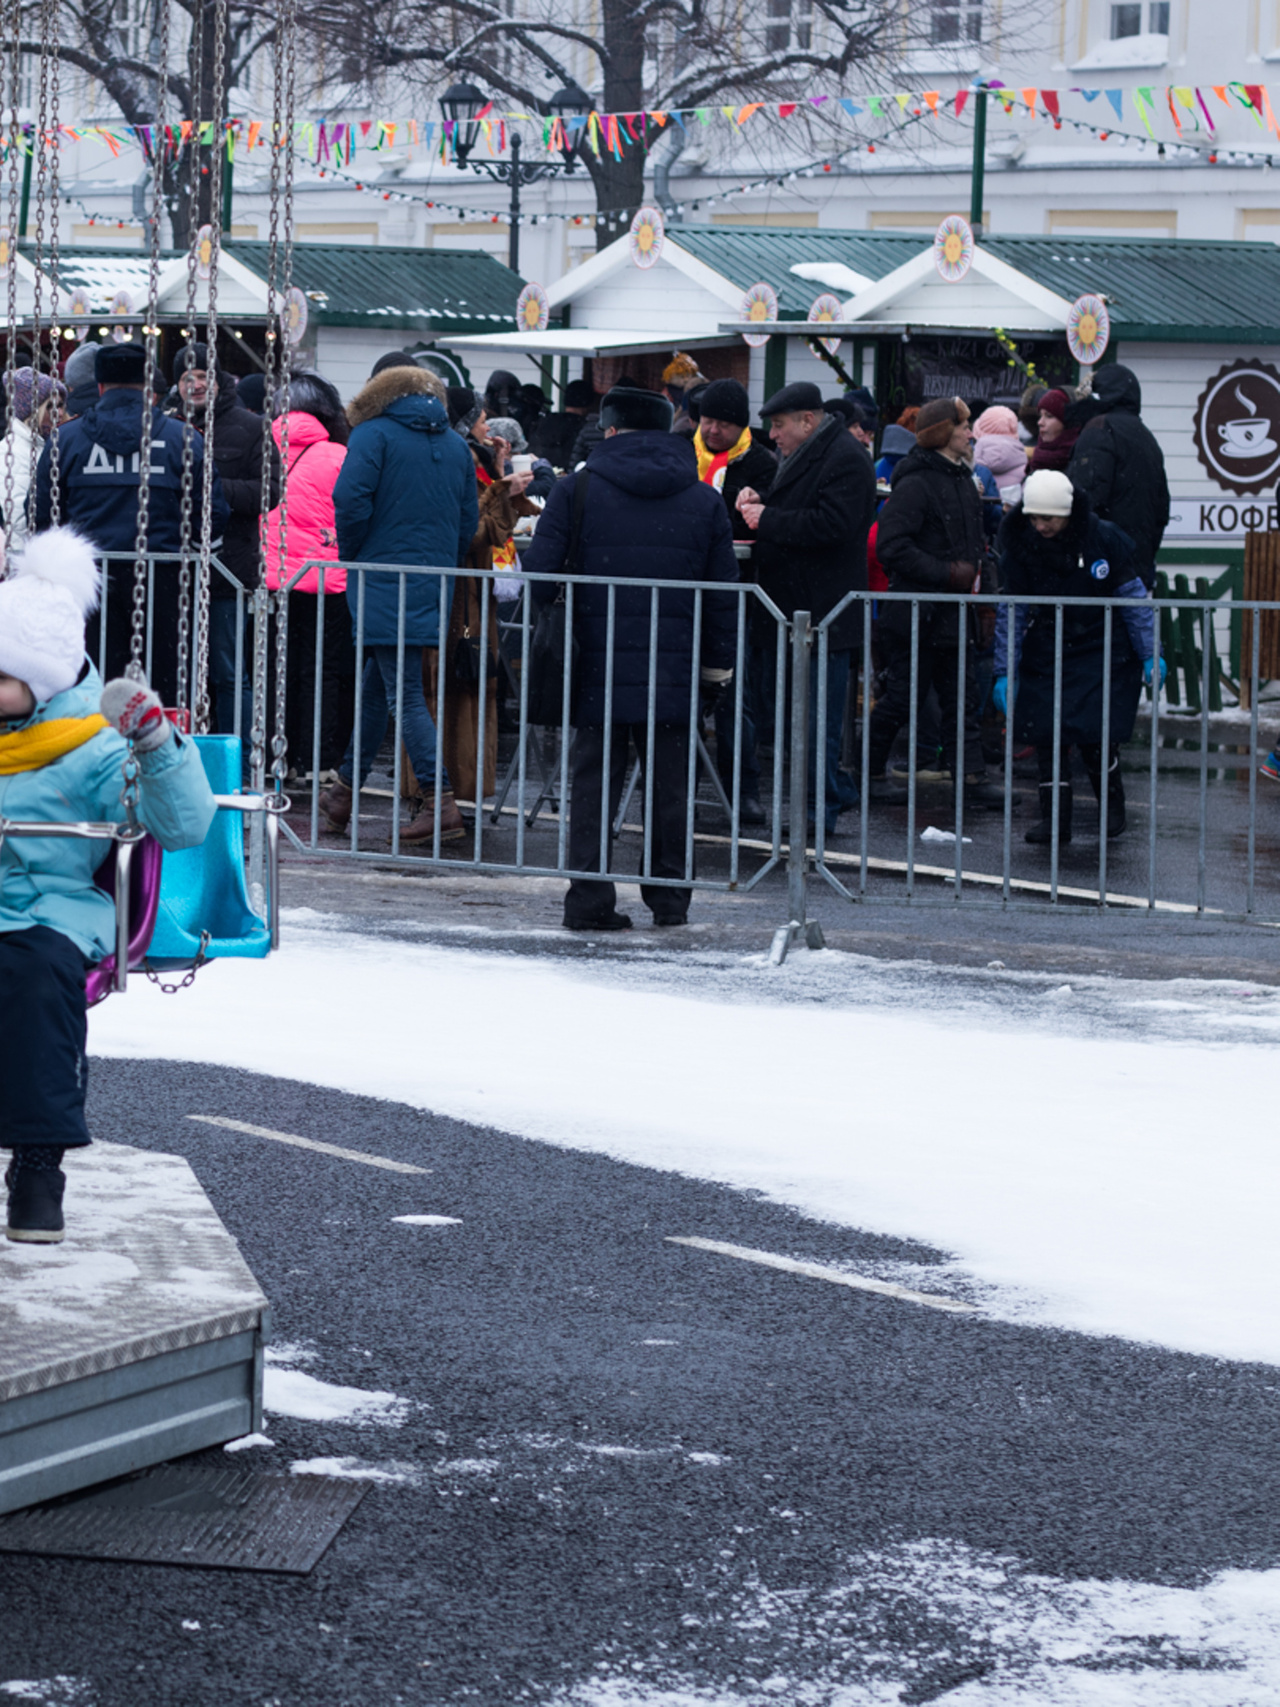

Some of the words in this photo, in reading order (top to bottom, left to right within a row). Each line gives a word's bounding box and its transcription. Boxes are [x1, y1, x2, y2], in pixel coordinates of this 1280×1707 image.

[985, 341, 1034, 359] GRUP
[923, 374, 993, 398] RESTAURANT
[83, 440, 165, 474] ДПС
[1200, 504, 1279, 533] КОФЕ
